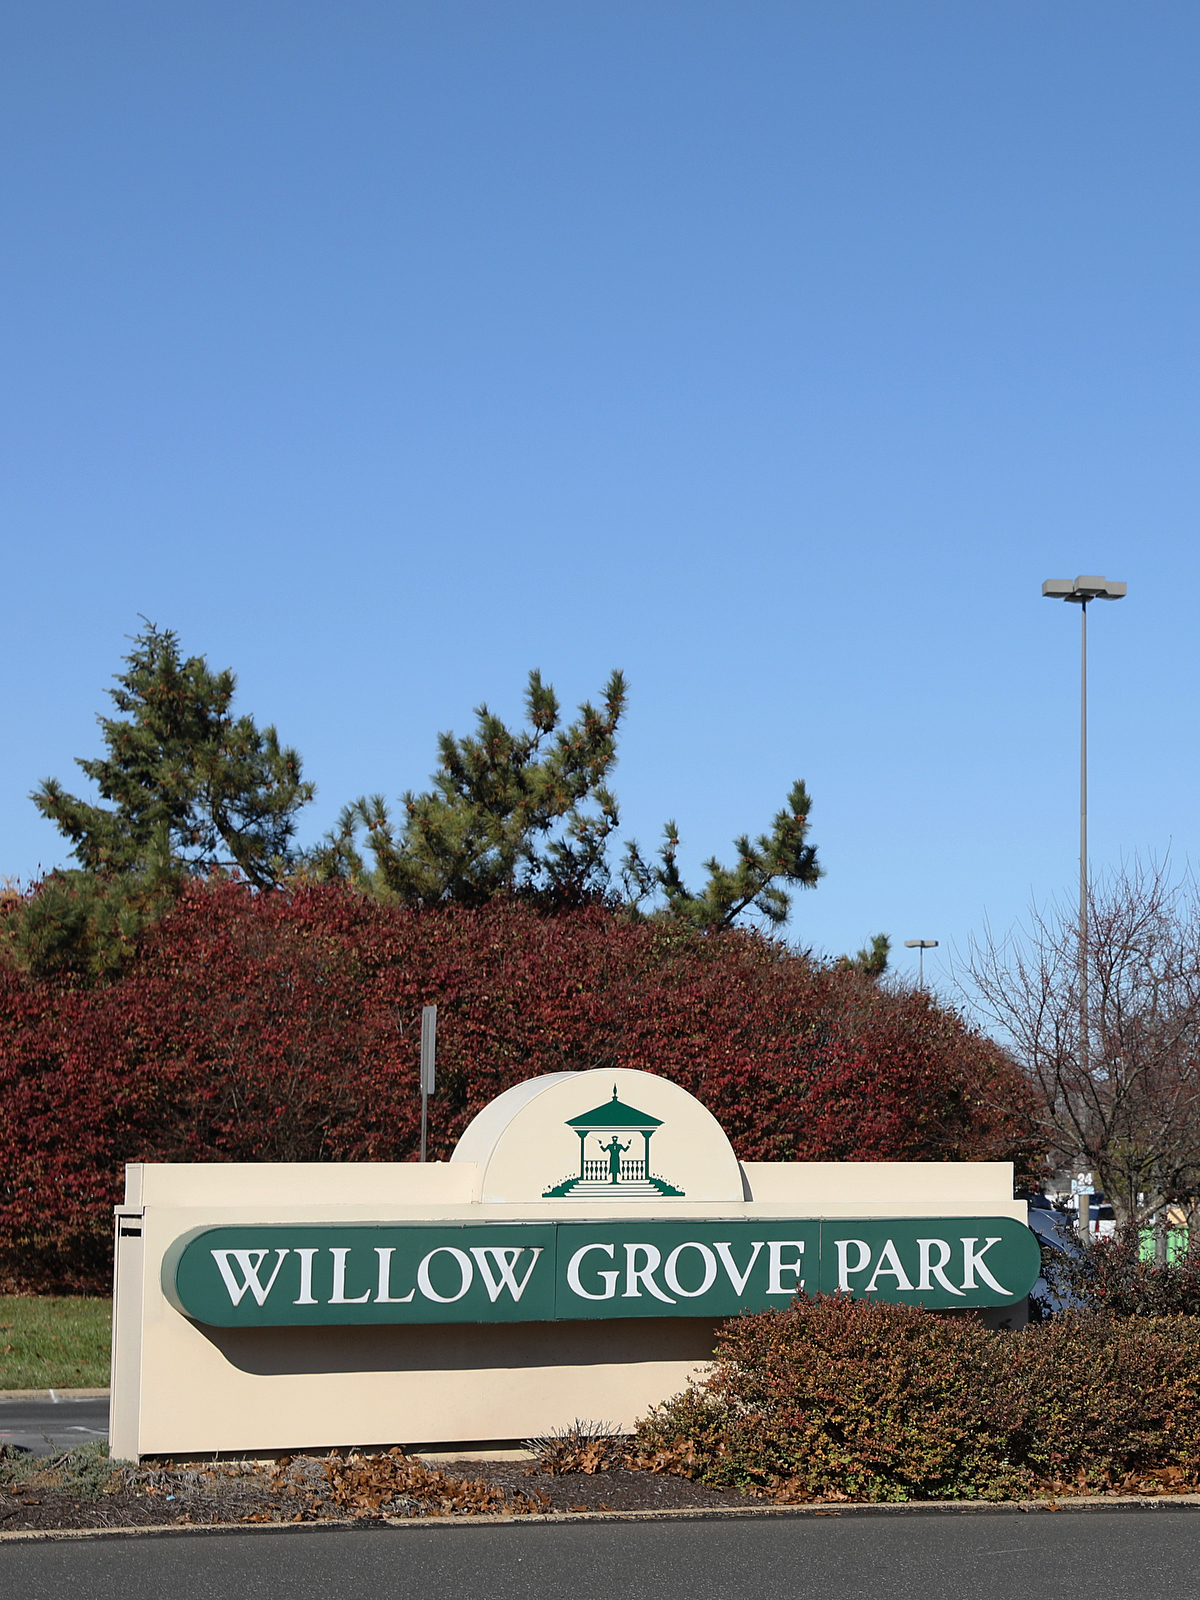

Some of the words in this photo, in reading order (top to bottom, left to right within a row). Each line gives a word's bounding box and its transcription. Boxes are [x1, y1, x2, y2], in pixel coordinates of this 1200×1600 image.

[1077, 1172, 1093, 1186] 24
[210, 1246, 544, 1307] WILLOW
[567, 1240, 805, 1304] GROVE
[833, 1237, 1014, 1297] PARK
